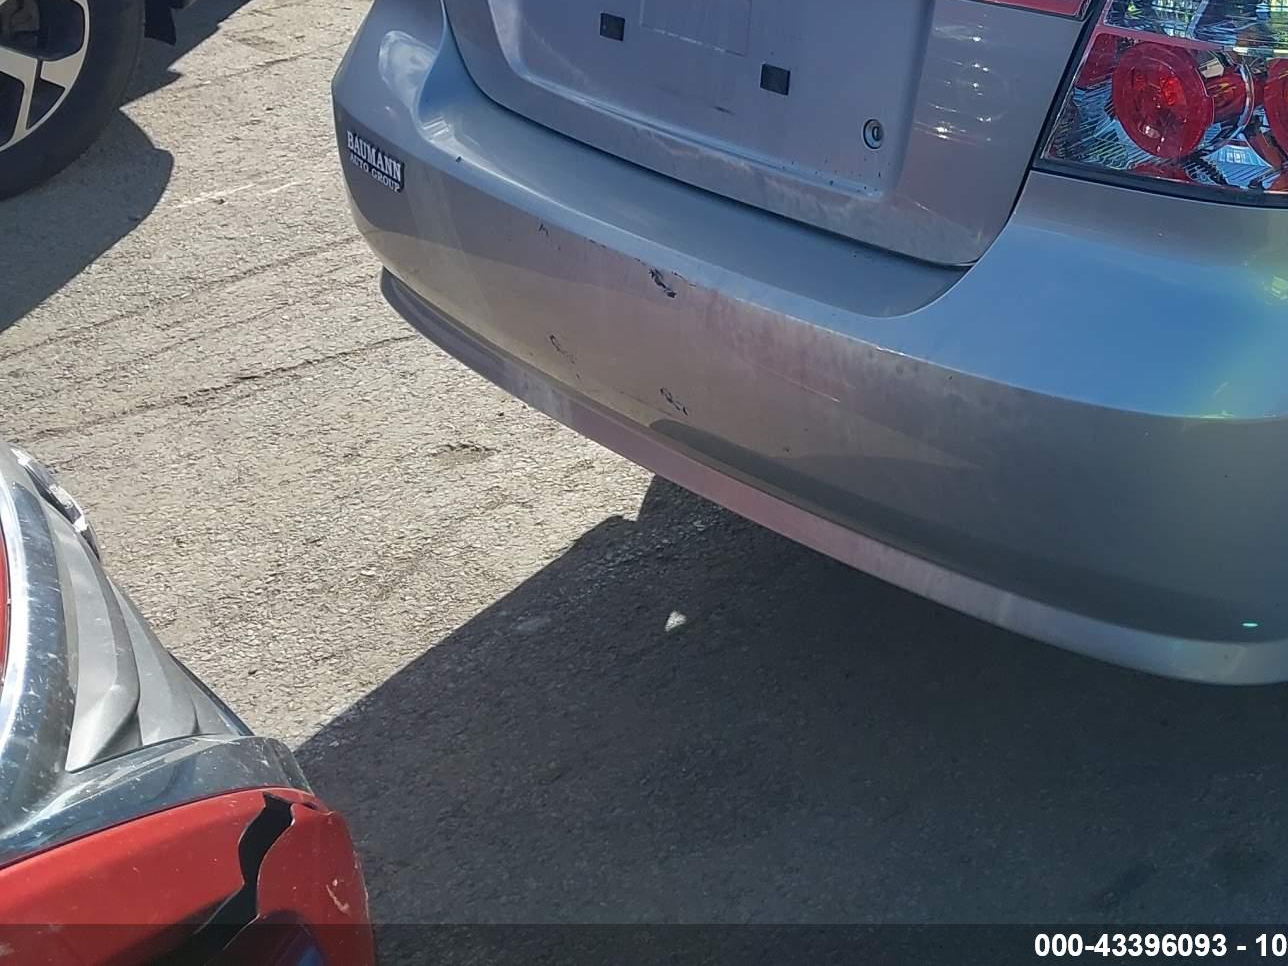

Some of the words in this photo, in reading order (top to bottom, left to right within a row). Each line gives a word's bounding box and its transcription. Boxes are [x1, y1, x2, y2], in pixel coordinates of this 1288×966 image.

[346, 130, 401, 182] BAUMANN
[350, 153, 369, 173] AUTO
[371, 168, 400, 192] GROUP
